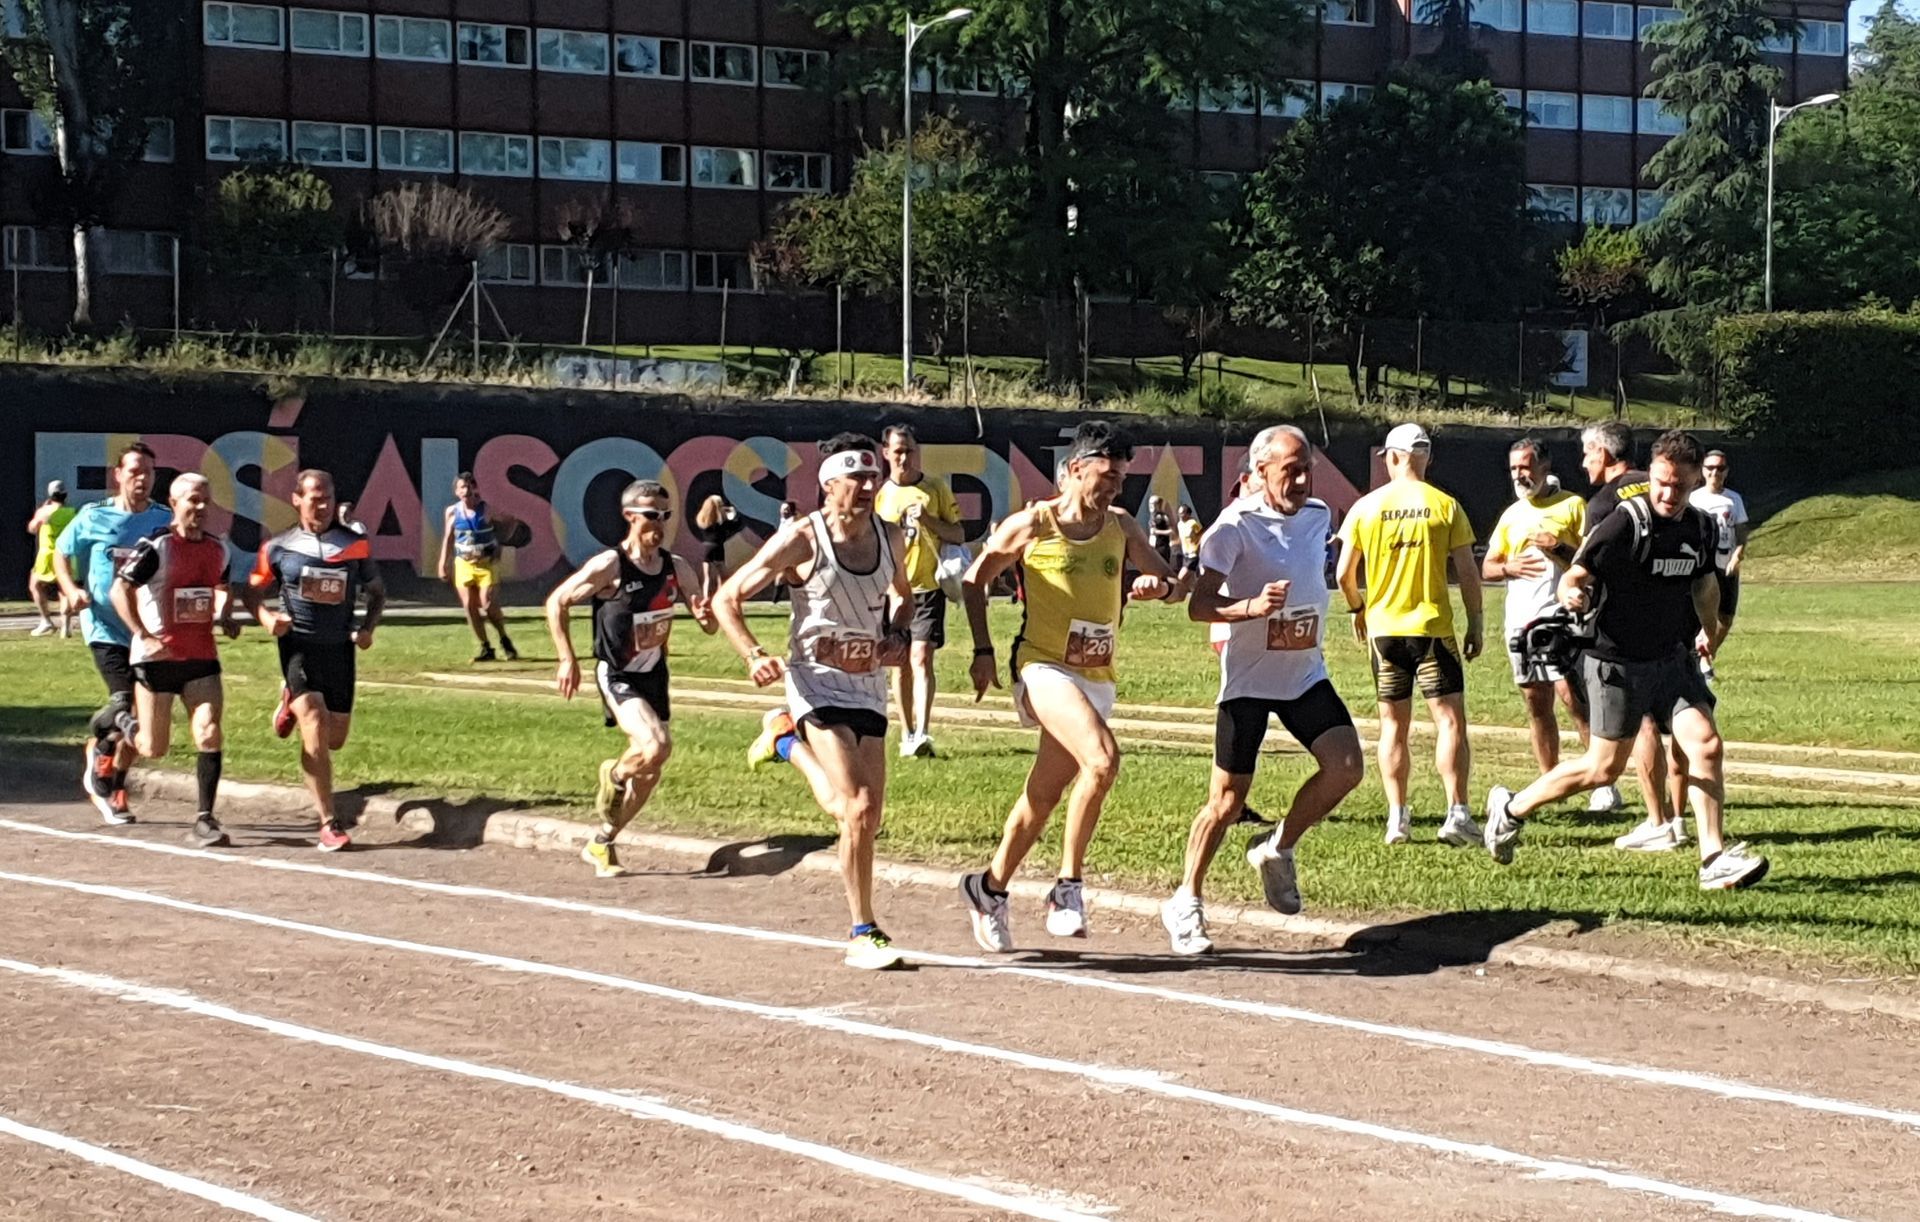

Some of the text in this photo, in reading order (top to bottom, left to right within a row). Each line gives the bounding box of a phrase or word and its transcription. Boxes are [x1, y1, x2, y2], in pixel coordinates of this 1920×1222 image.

[1651, 558, 1696, 577] PUMA
[320, 579, 340, 593] 86
[1294, 617, 1315, 638] 57
[839, 640, 872, 660] 123
